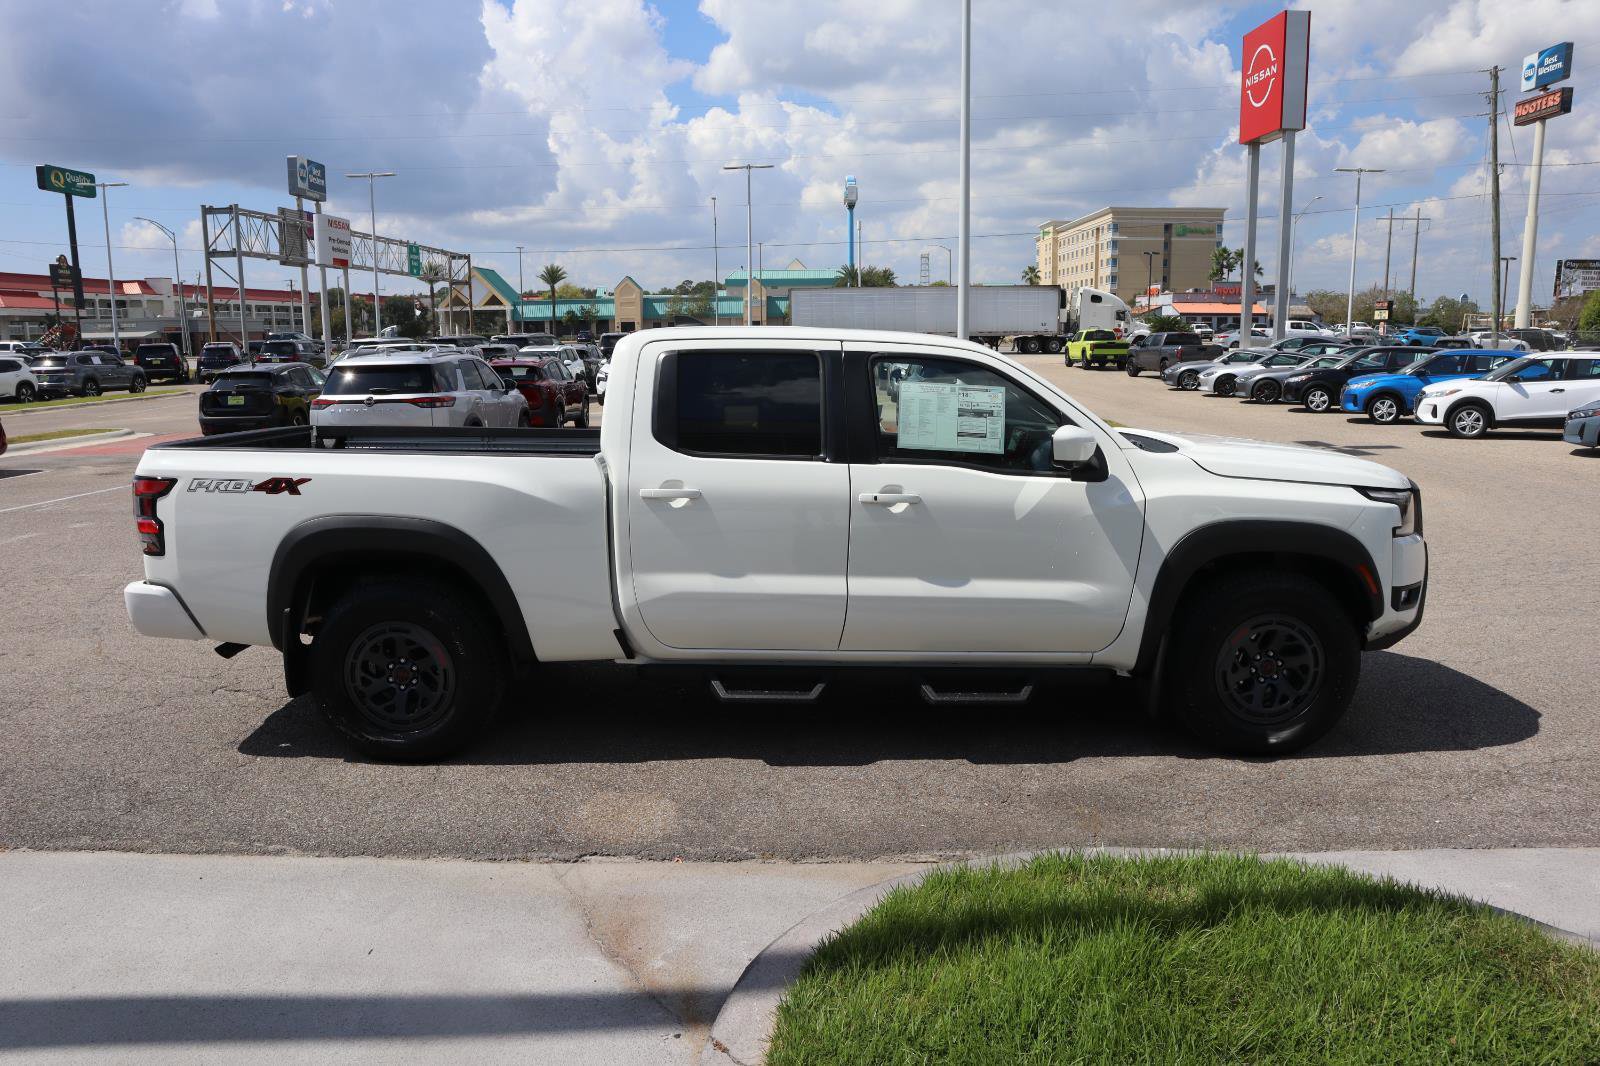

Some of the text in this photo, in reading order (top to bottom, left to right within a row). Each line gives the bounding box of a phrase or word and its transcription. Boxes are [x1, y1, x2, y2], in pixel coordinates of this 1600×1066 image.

[1544, 55, 1558, 66] Best
[1245, 63, 1277, 88] NISSAN
[1537, 62, 1563, 76] Western
[1515, 93, 1561, 117] HOOTERS
[65, 172, 91, 184] Quality
[327, 218, 350, 231] NISSAN
[187, 477, 313, 496] PRO-4X
